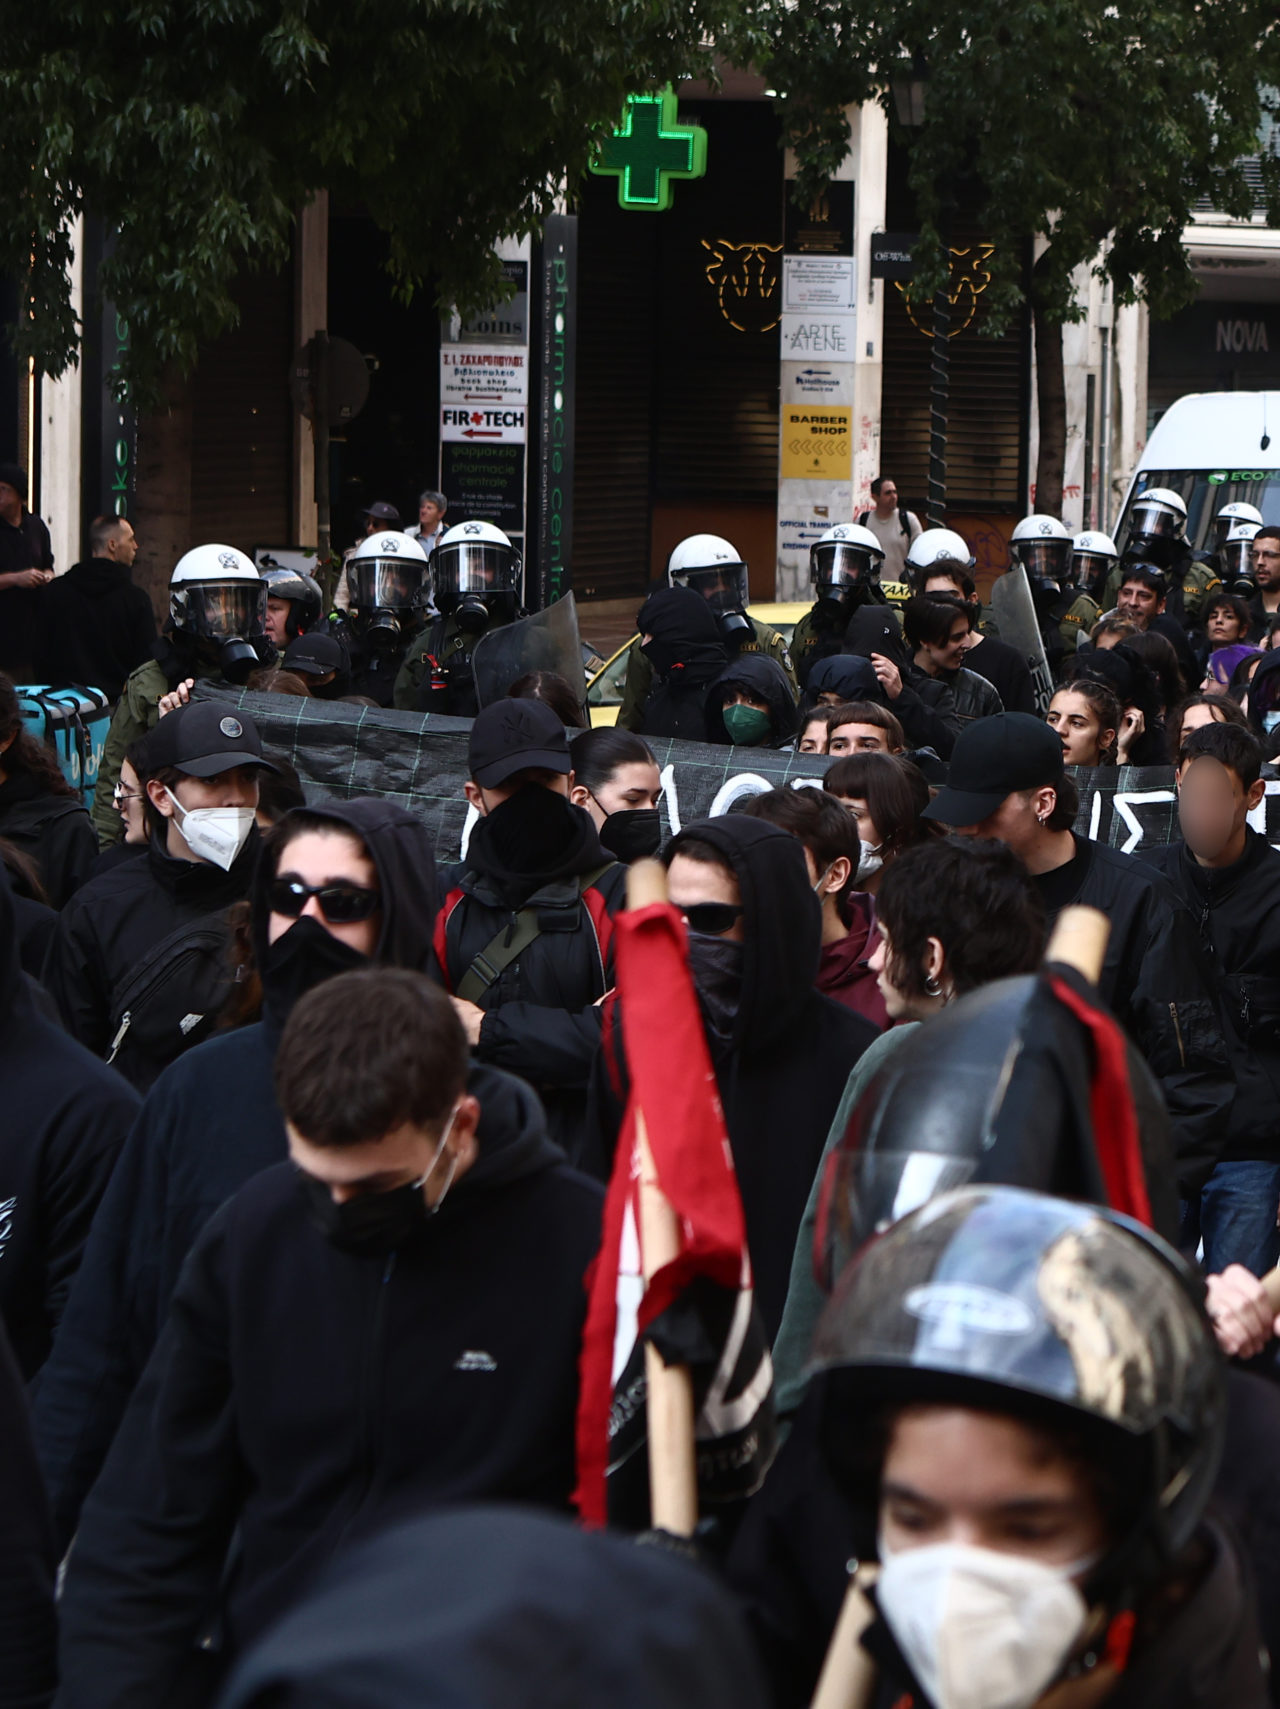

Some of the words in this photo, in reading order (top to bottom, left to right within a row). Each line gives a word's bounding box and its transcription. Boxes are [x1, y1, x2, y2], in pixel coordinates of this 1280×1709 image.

[798, 324, 842, 340] ARTE
[1216, 319, 1269, 353] NOVA
[790, 337, 848, 352] ATENE
[552, 258, 569, 474] pharmacie
[790, 415, 848, 425] BARBER
[810, 426, 848, 436] SHOP
[451, 463, 516, 475] pharmacie
[459, 477, 508, 488] centrale
[780, 520, 808, 528] OFFICIAL
